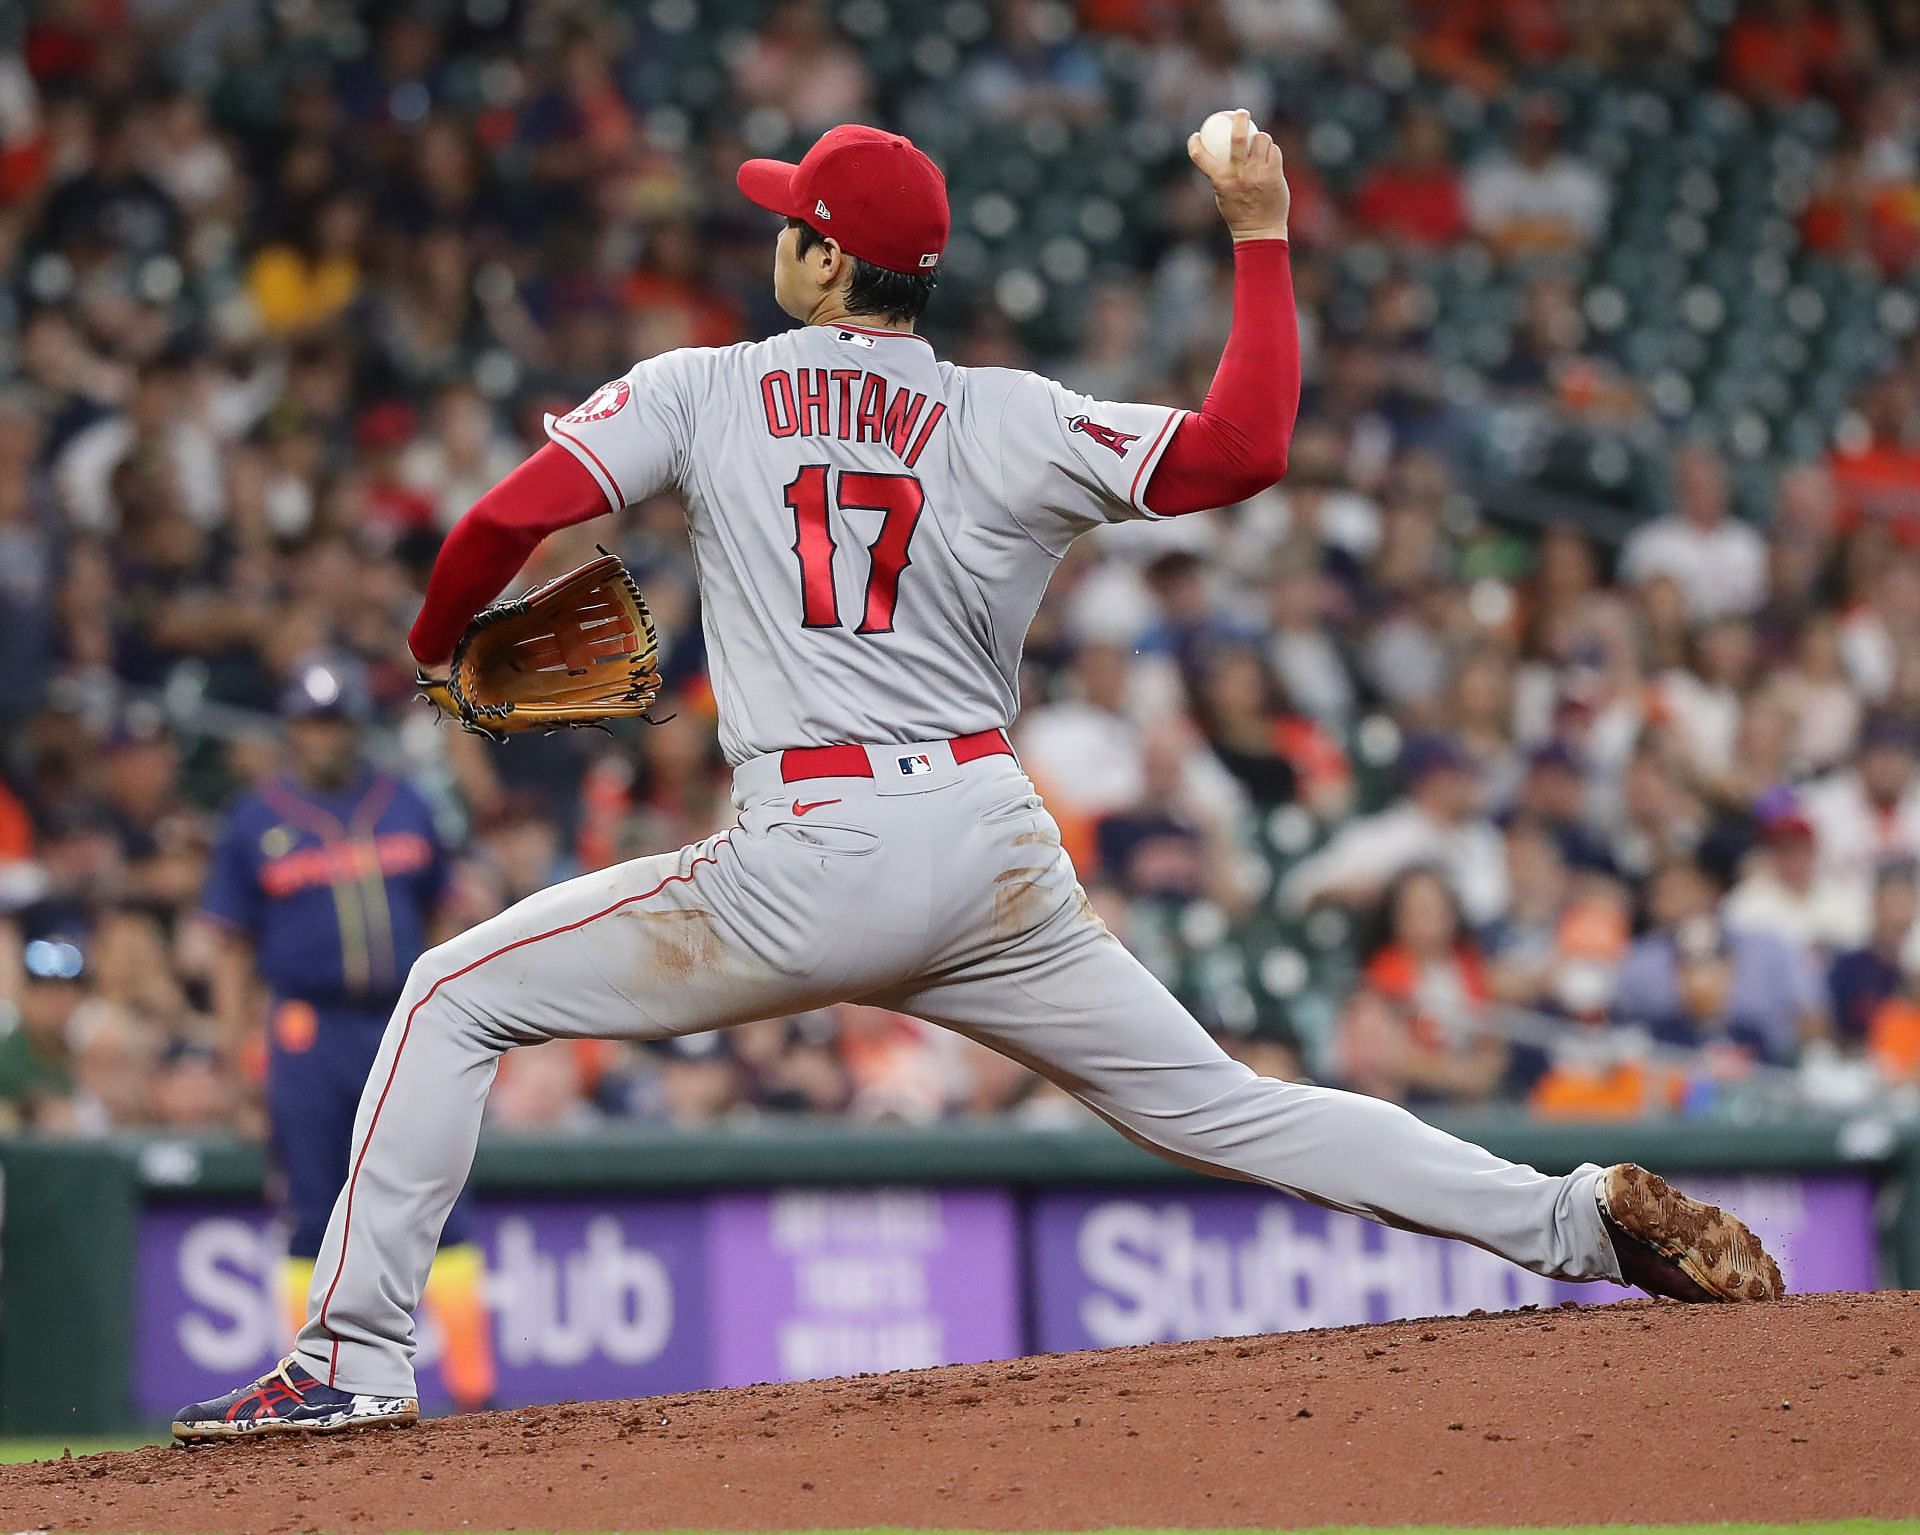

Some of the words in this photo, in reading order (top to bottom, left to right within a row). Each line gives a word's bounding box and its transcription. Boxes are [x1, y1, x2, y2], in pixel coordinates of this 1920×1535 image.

[760, 368, 947, 469] OHTANI
[783, 464, 925, 635] 17
[178, 1216, 674, 1373] SHub
